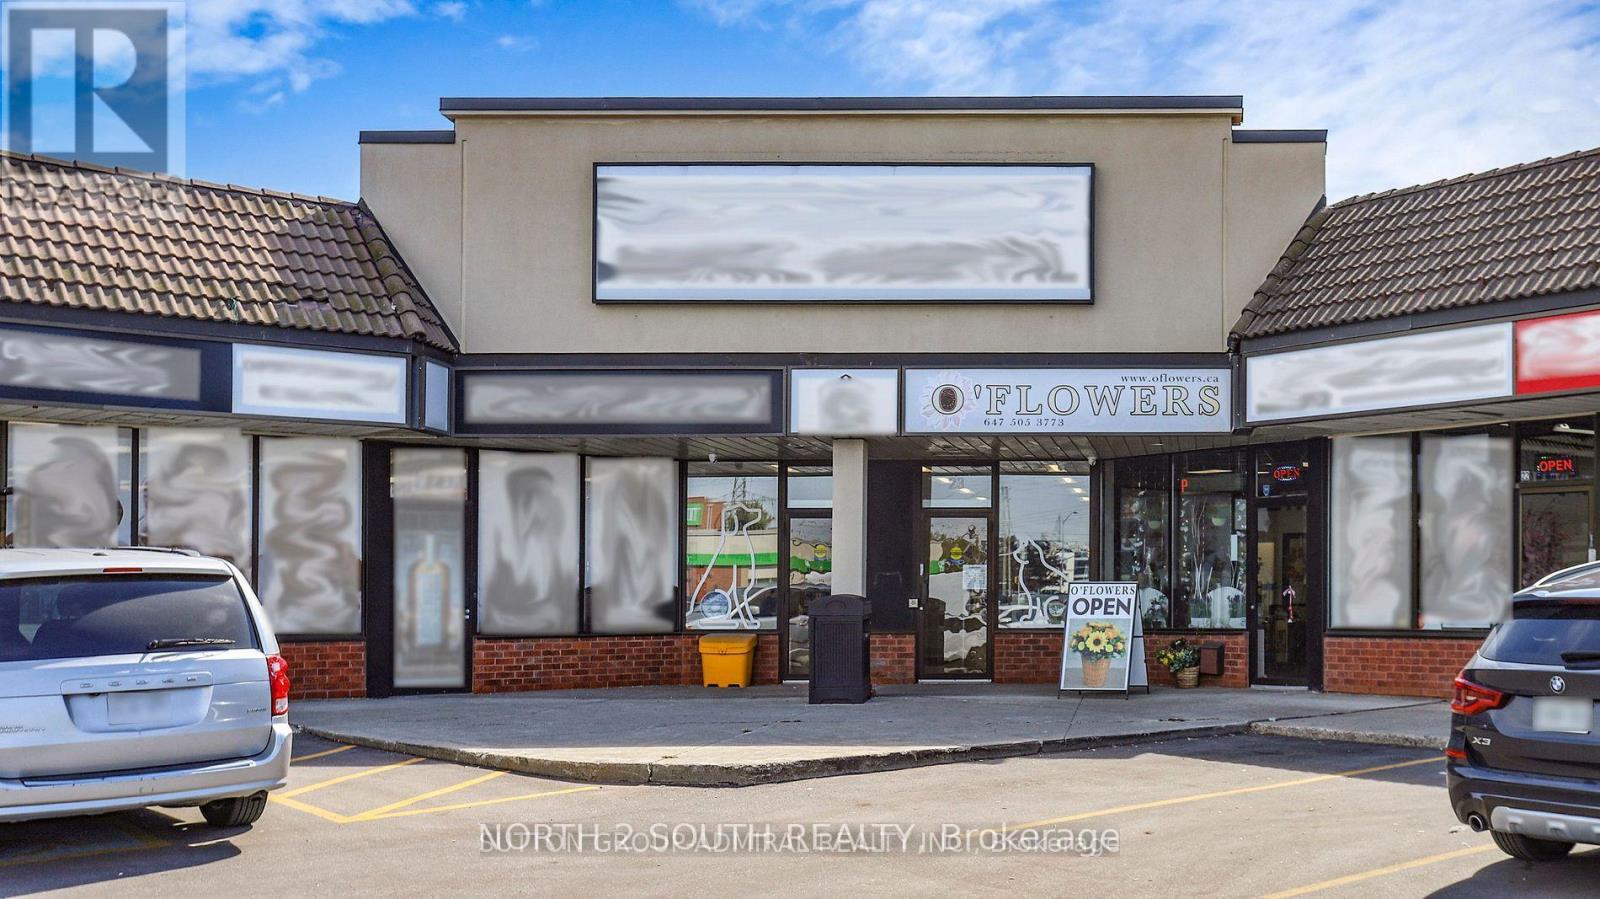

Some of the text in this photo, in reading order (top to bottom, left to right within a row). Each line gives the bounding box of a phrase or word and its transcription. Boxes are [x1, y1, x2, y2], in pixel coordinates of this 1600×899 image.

[1120, 373, 1219, 383] www.oflowers.ca
[931, 383, 1221, 417] O'FLOWERS
[983, 418, 1065, 427] 647 505 3773
[1540, 459, 1573, 472] OPEN
[1273, 468, 1301, 479] OPEN
[1070, 585, 1136, 596] O'FLOWERS
[1072, 597, 1132, 616] OPEN
[1471, 736, 1491, 746] X3
